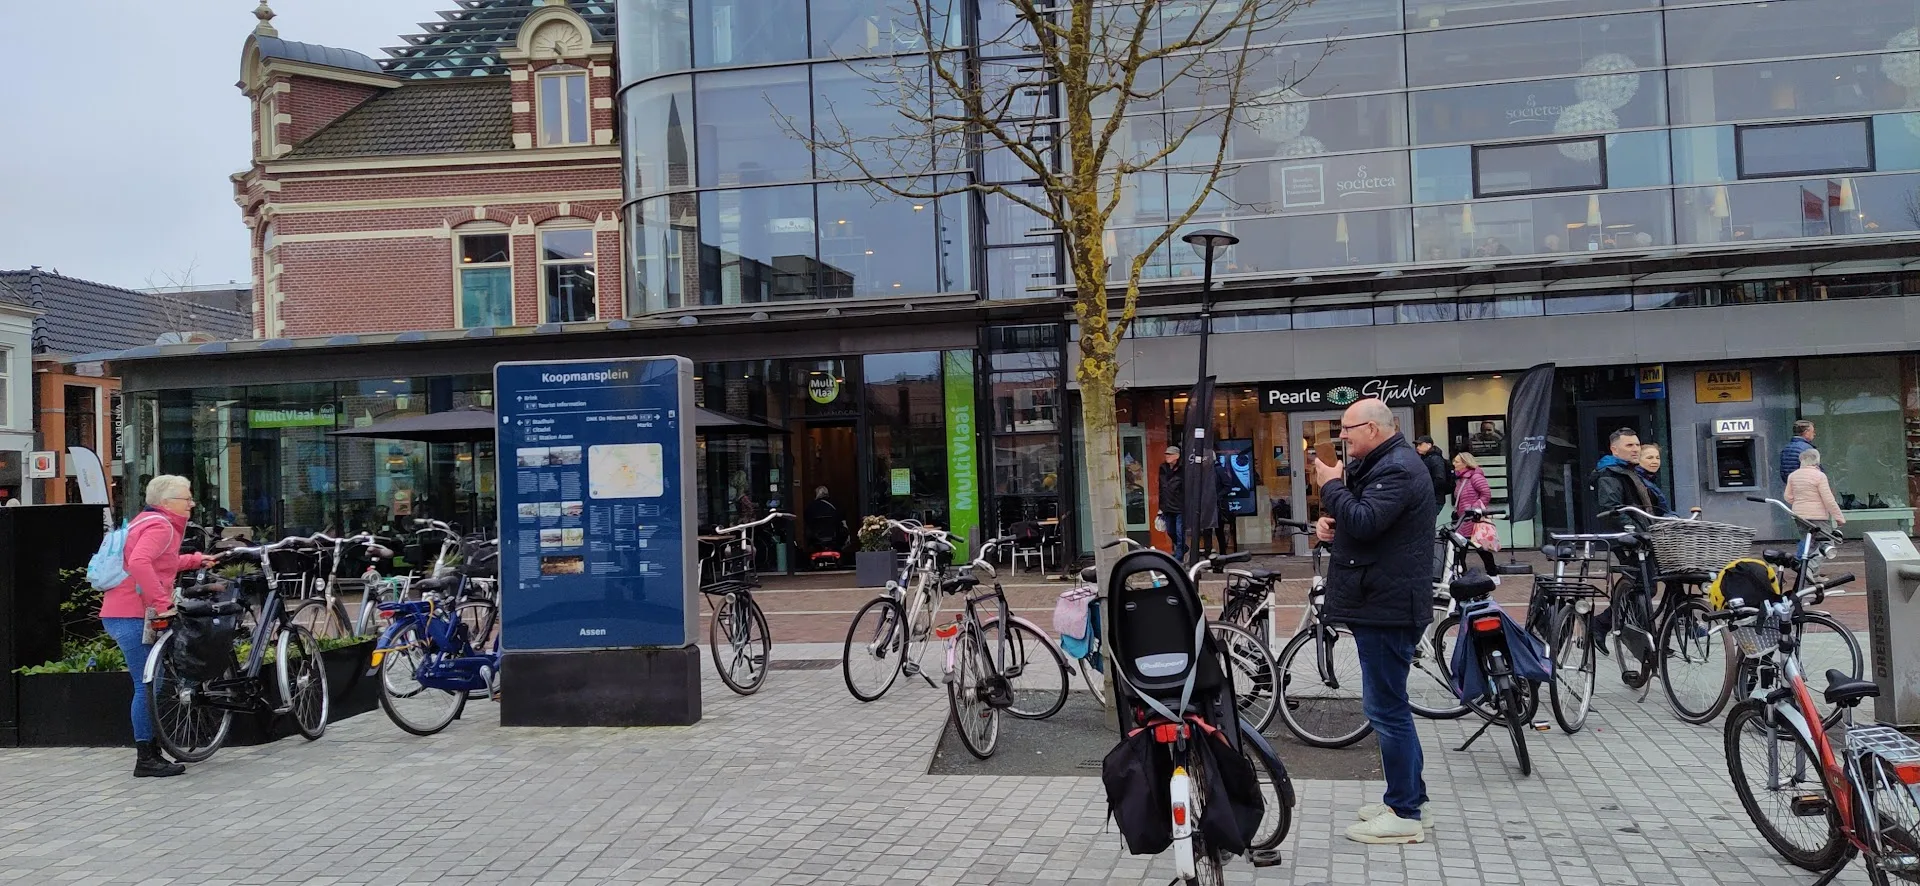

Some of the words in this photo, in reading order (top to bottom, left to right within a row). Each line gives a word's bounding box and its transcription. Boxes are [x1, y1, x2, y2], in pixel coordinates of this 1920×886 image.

[1336, 176, 1396, 191] societea
[541, 369, 629, 384] Koopmansplein
[1642, 369, 1660, 381] ATM
[1707, 371, 1741, 384] ATM
[1268, 389, 1321, 404] Pearle
[1361, 379, 1432, 404] Studio
[254, 408, 314, 422] MultiVlaai
[1721, 421, 1750, 431] ATM
[951, 405, 972, 511] MultiVlaai
[579, 628, 607, 636] Assen
[1874, 615, 1888, 678] DRENTS
